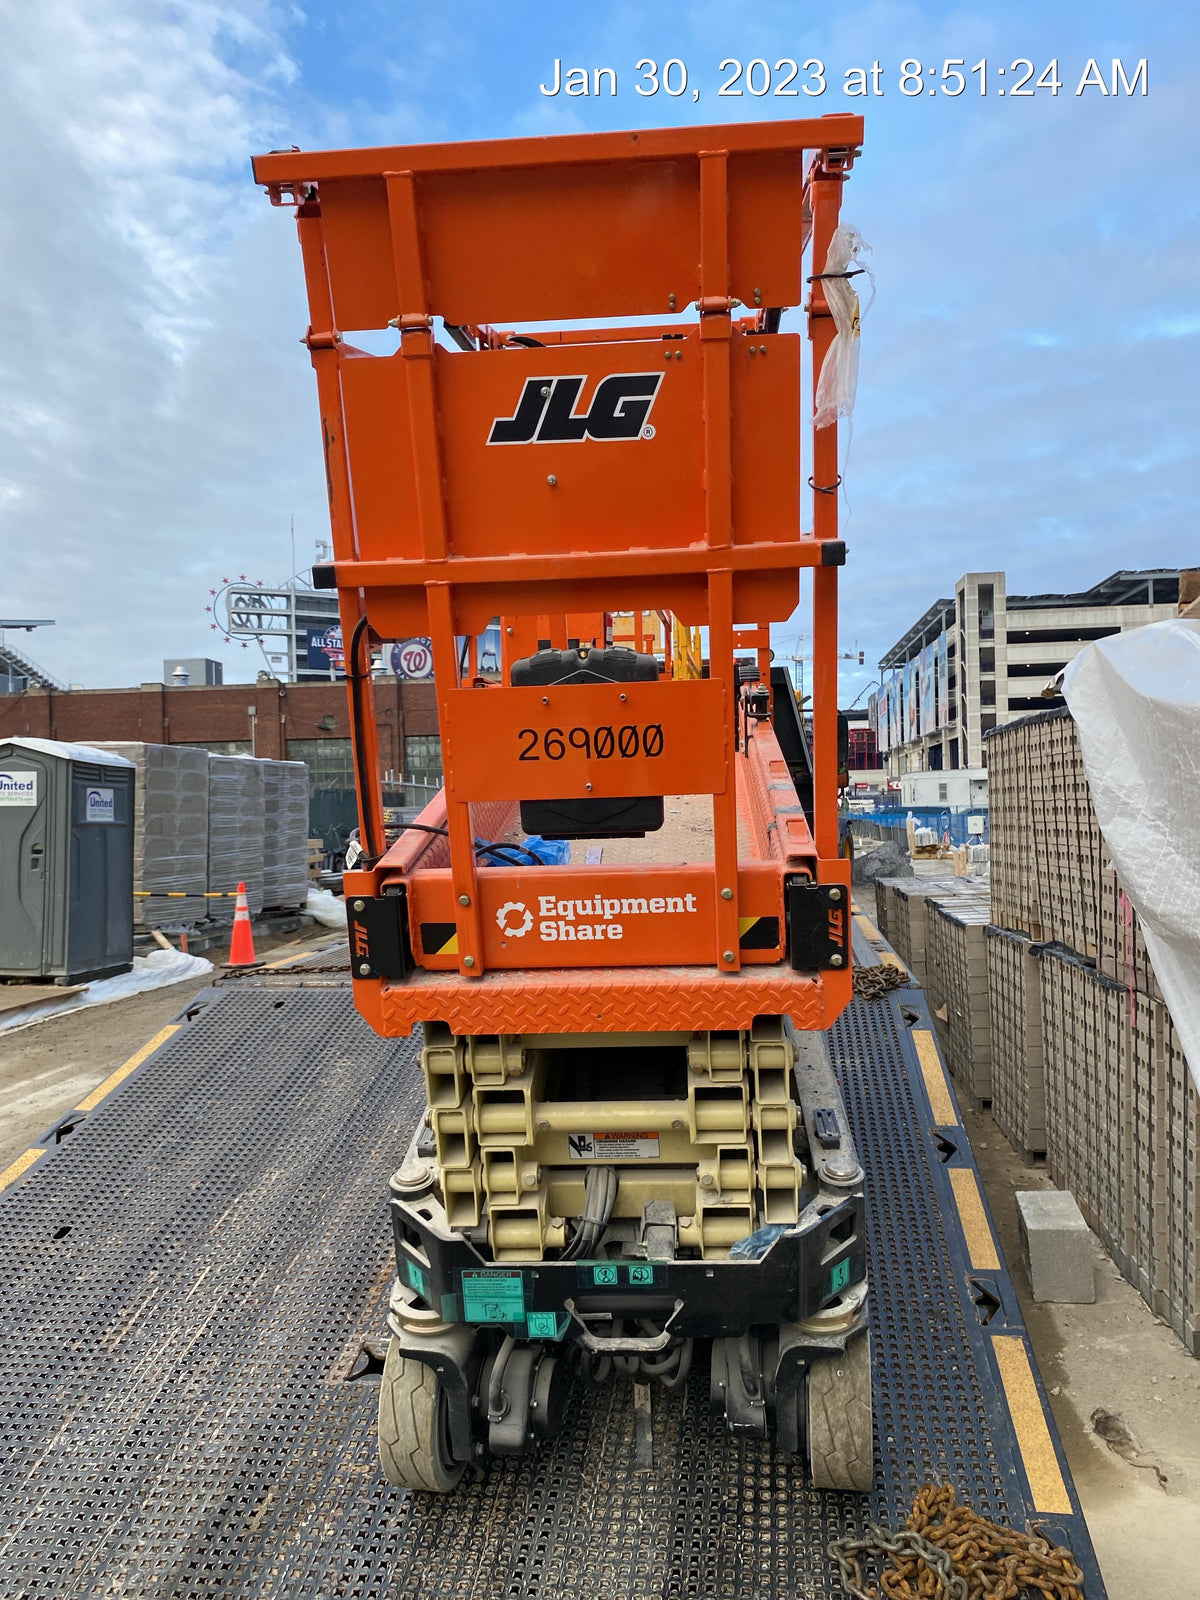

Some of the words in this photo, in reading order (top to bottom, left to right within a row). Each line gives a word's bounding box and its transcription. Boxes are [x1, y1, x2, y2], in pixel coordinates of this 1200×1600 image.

[486, 371, 665, 446] JLG
[311, 637, 325, 648] ALL
[518, 724, 664, 761] 269000
[90, 797, 113, 808] United
[538, 893, 697, 921] Equipment
[353, 919, 370, 958] JLG
[539, 920, 623, 942] Share
[828, 908, 844, 948] JLG
